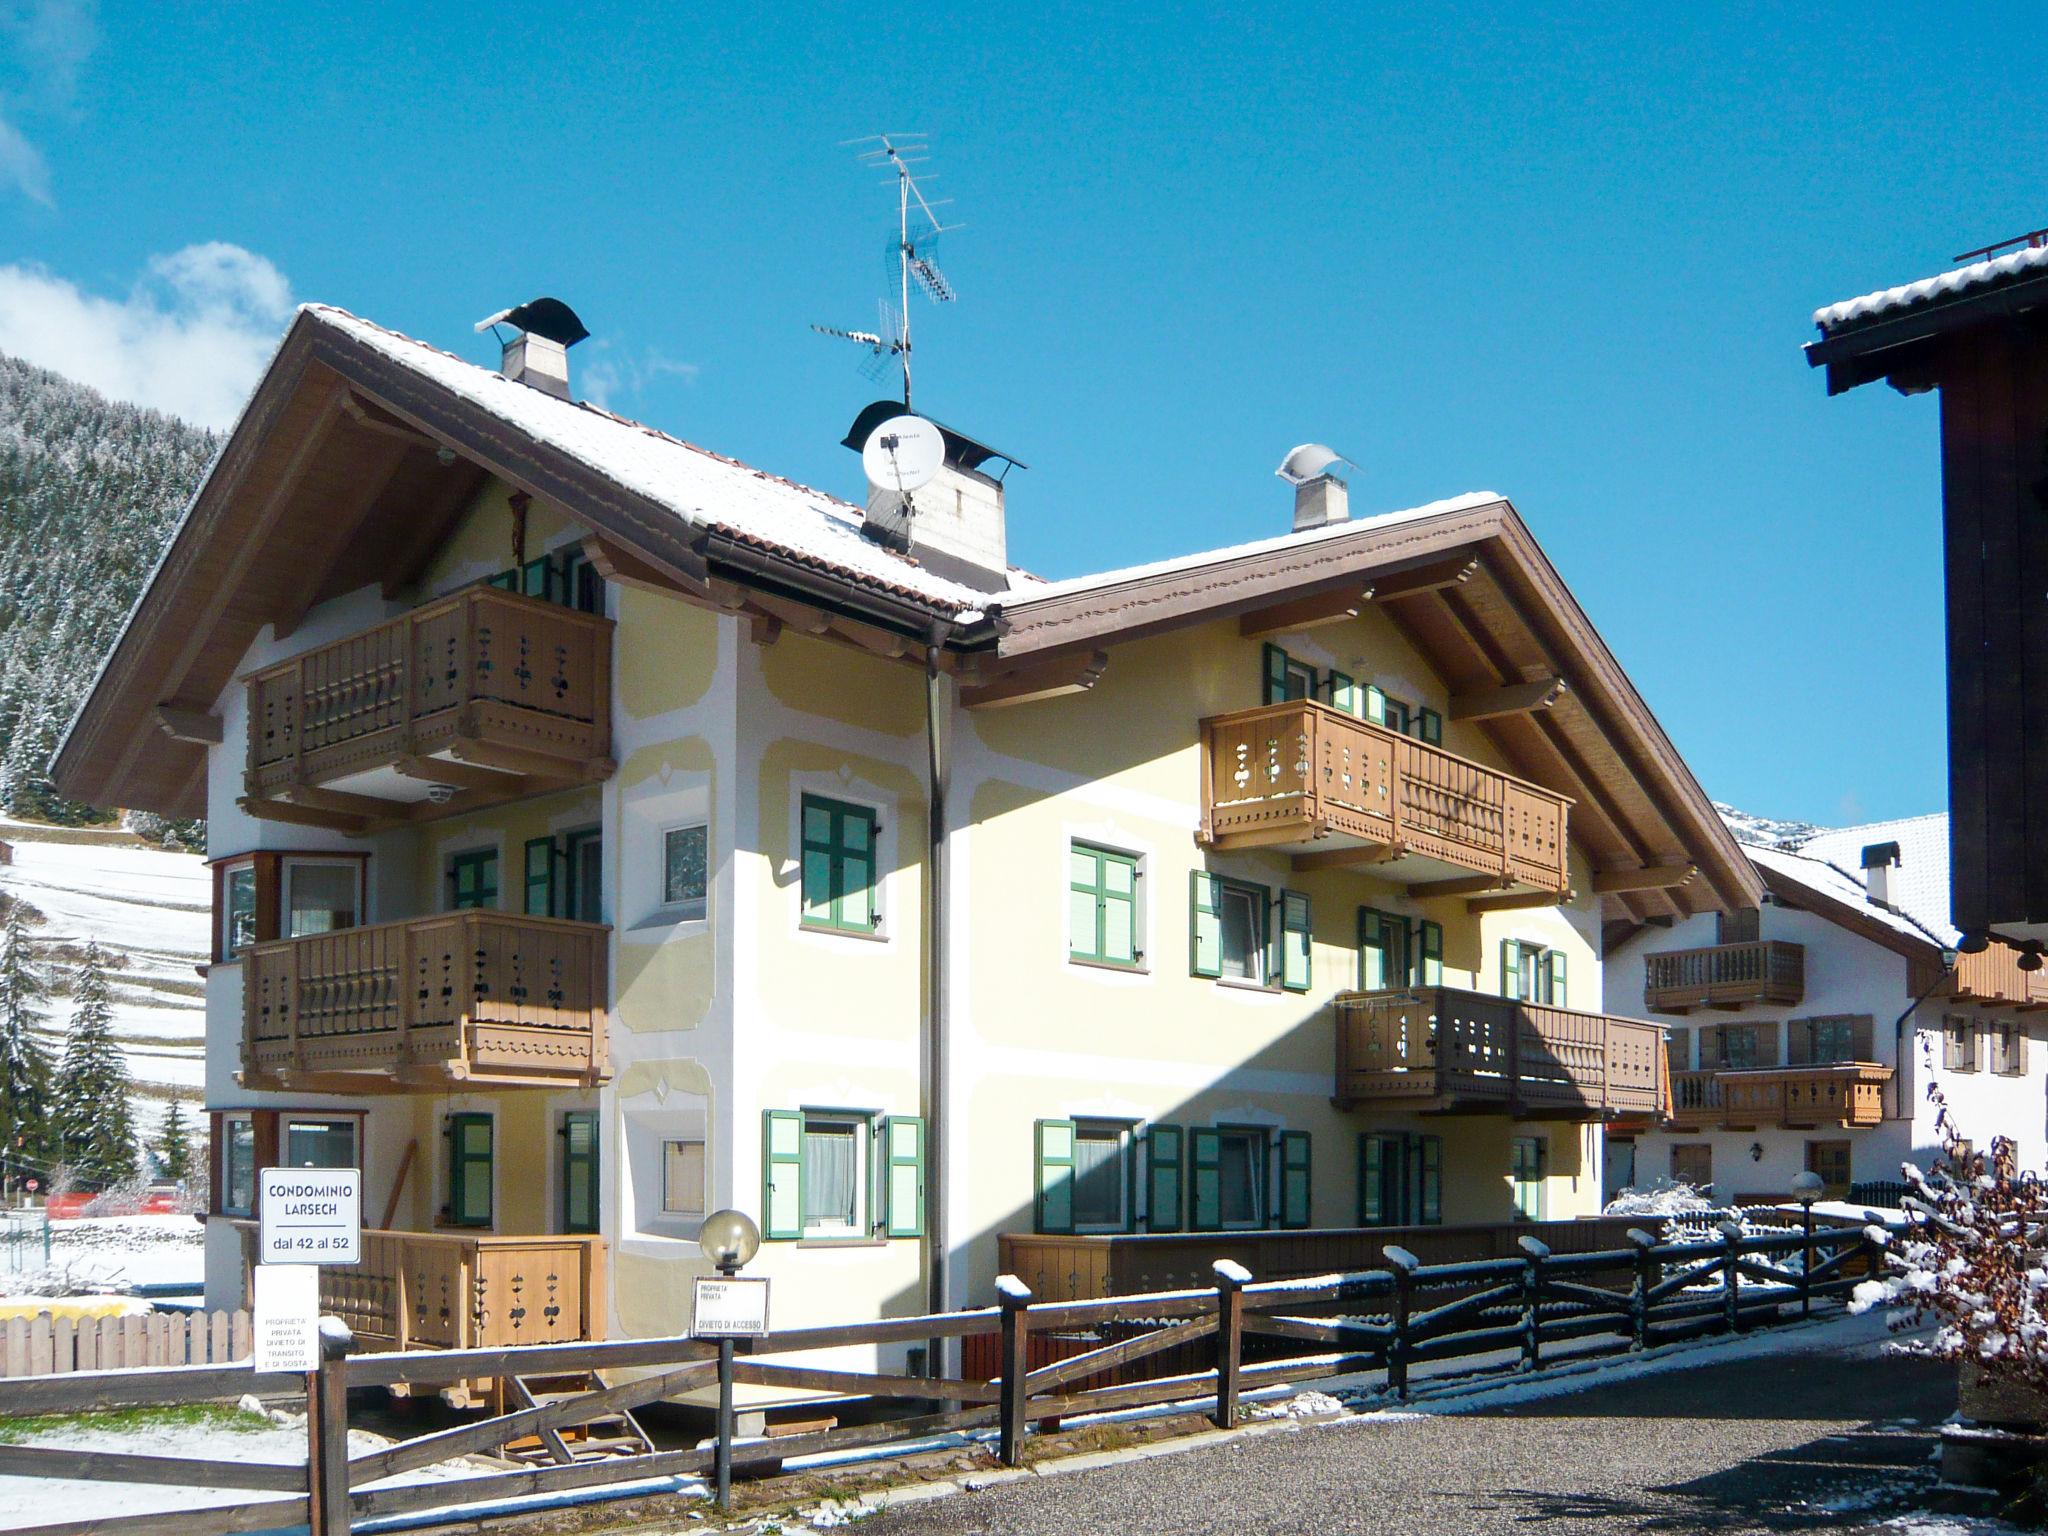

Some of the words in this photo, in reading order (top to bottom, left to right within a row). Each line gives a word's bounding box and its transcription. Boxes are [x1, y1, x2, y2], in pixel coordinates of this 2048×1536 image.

[269, 1185, 353, 1198] CONDOMINIO
[285, 1203, 337, 1216] LARSECH
[273, 1238, 293, 1250] dal
[296, 1238, 314, 1249] 42
[317, 1237, 329, 1249] al
[332, 1237, 349, 1249] 52
[698, 1320, 722, 1329] DIVIETO
[724, 1320, 731, 1329] DI
[732, 1320, 761, 1329] ACCESSO
[271, 1329, 302, 1337] PRIVATA
[266, 1339, 296, 1347] DIVIETO
[267, 1350, 305, 1358] TRANSITO
[282, 1360, 308, 1368] SOSTA
